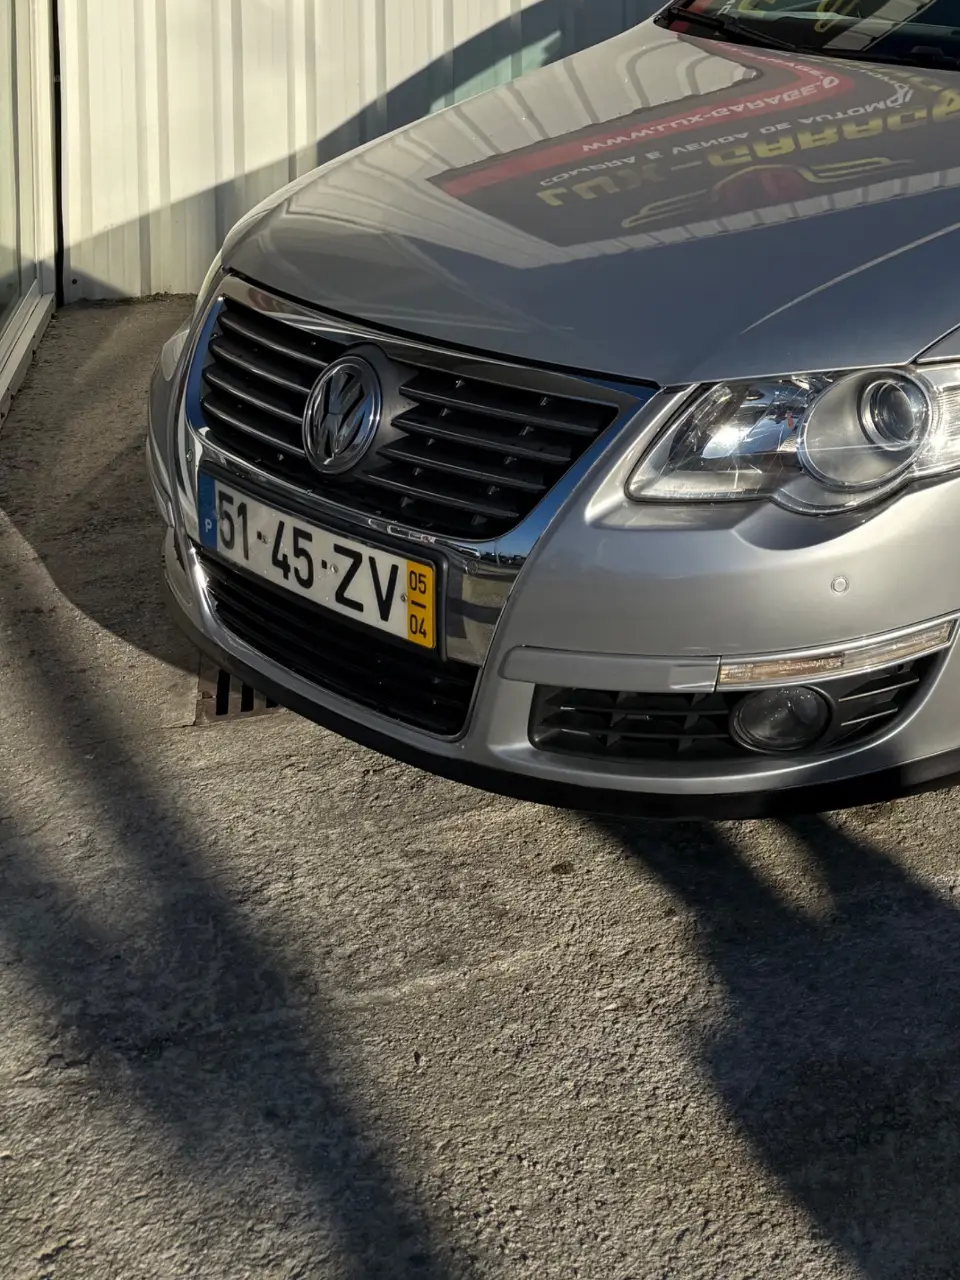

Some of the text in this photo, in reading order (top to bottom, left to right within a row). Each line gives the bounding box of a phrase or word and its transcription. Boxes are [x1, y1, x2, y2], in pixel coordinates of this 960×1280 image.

[204, 518, 212, 533] P
[409, 570, 427, 595] 05
[409, 614, 427, 639] 04
